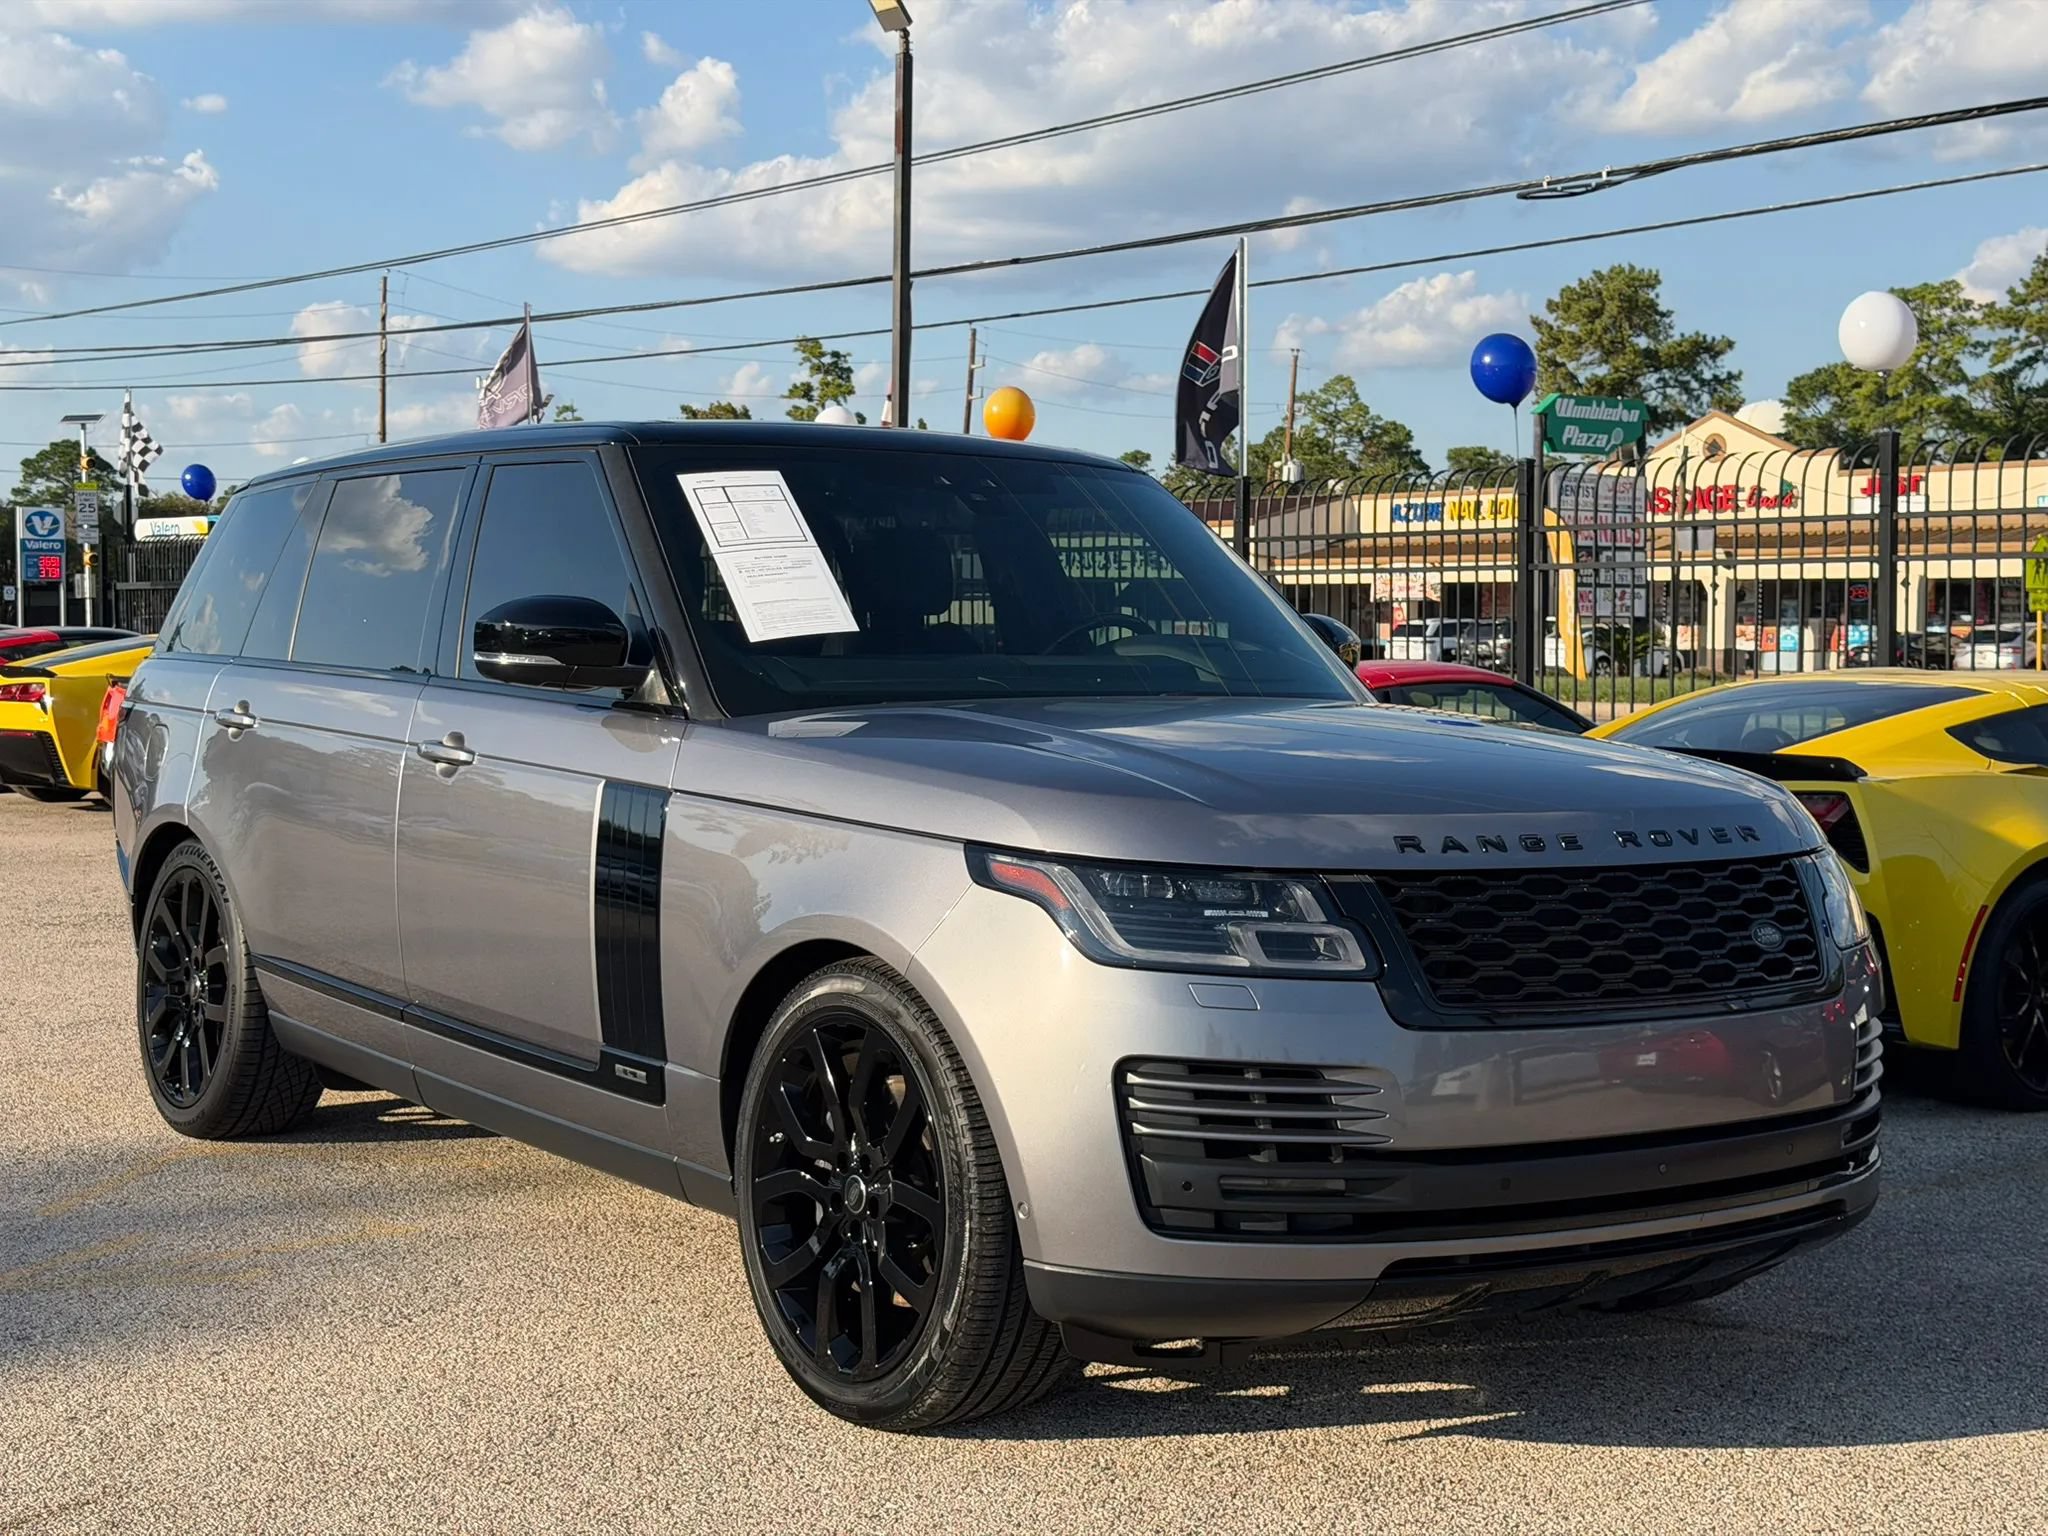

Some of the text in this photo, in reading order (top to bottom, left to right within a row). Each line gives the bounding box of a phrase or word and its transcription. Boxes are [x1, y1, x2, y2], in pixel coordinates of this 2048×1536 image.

[1555, 398, 1640, 422] Wimbledon
[1562, 425, 1608, 447] Plaza
[79, 503, 96, 513] 25
[1448, 500, 1488, 521] NAIL
[25, 540, 61, 549] Valero
[1393, 824, 1761, 854] RANGE ROVER
